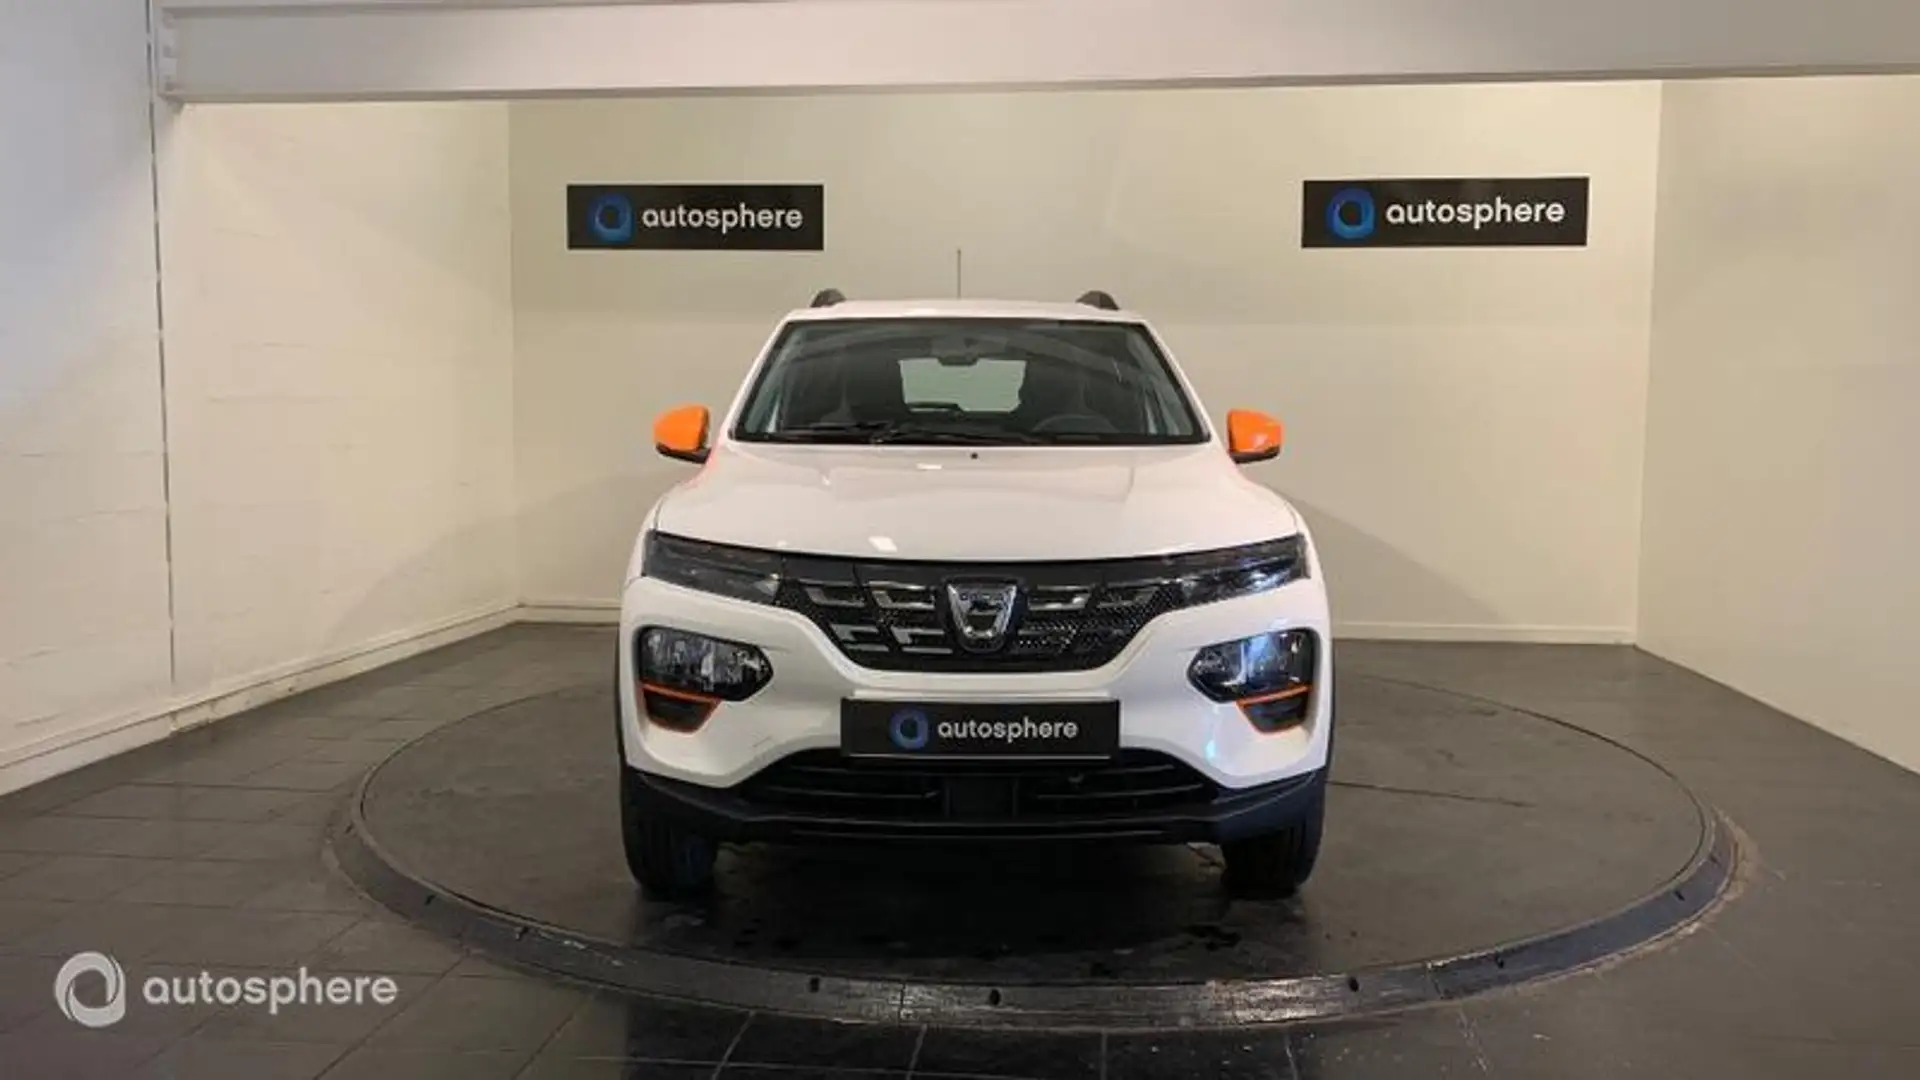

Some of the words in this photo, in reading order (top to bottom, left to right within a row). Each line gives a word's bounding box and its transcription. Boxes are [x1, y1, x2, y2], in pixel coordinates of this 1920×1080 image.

[642, 203, 803, 234] autosphere
[1386, 197, 1565, 230] autosphere
[937, 716, 1078, 743] autosphere
